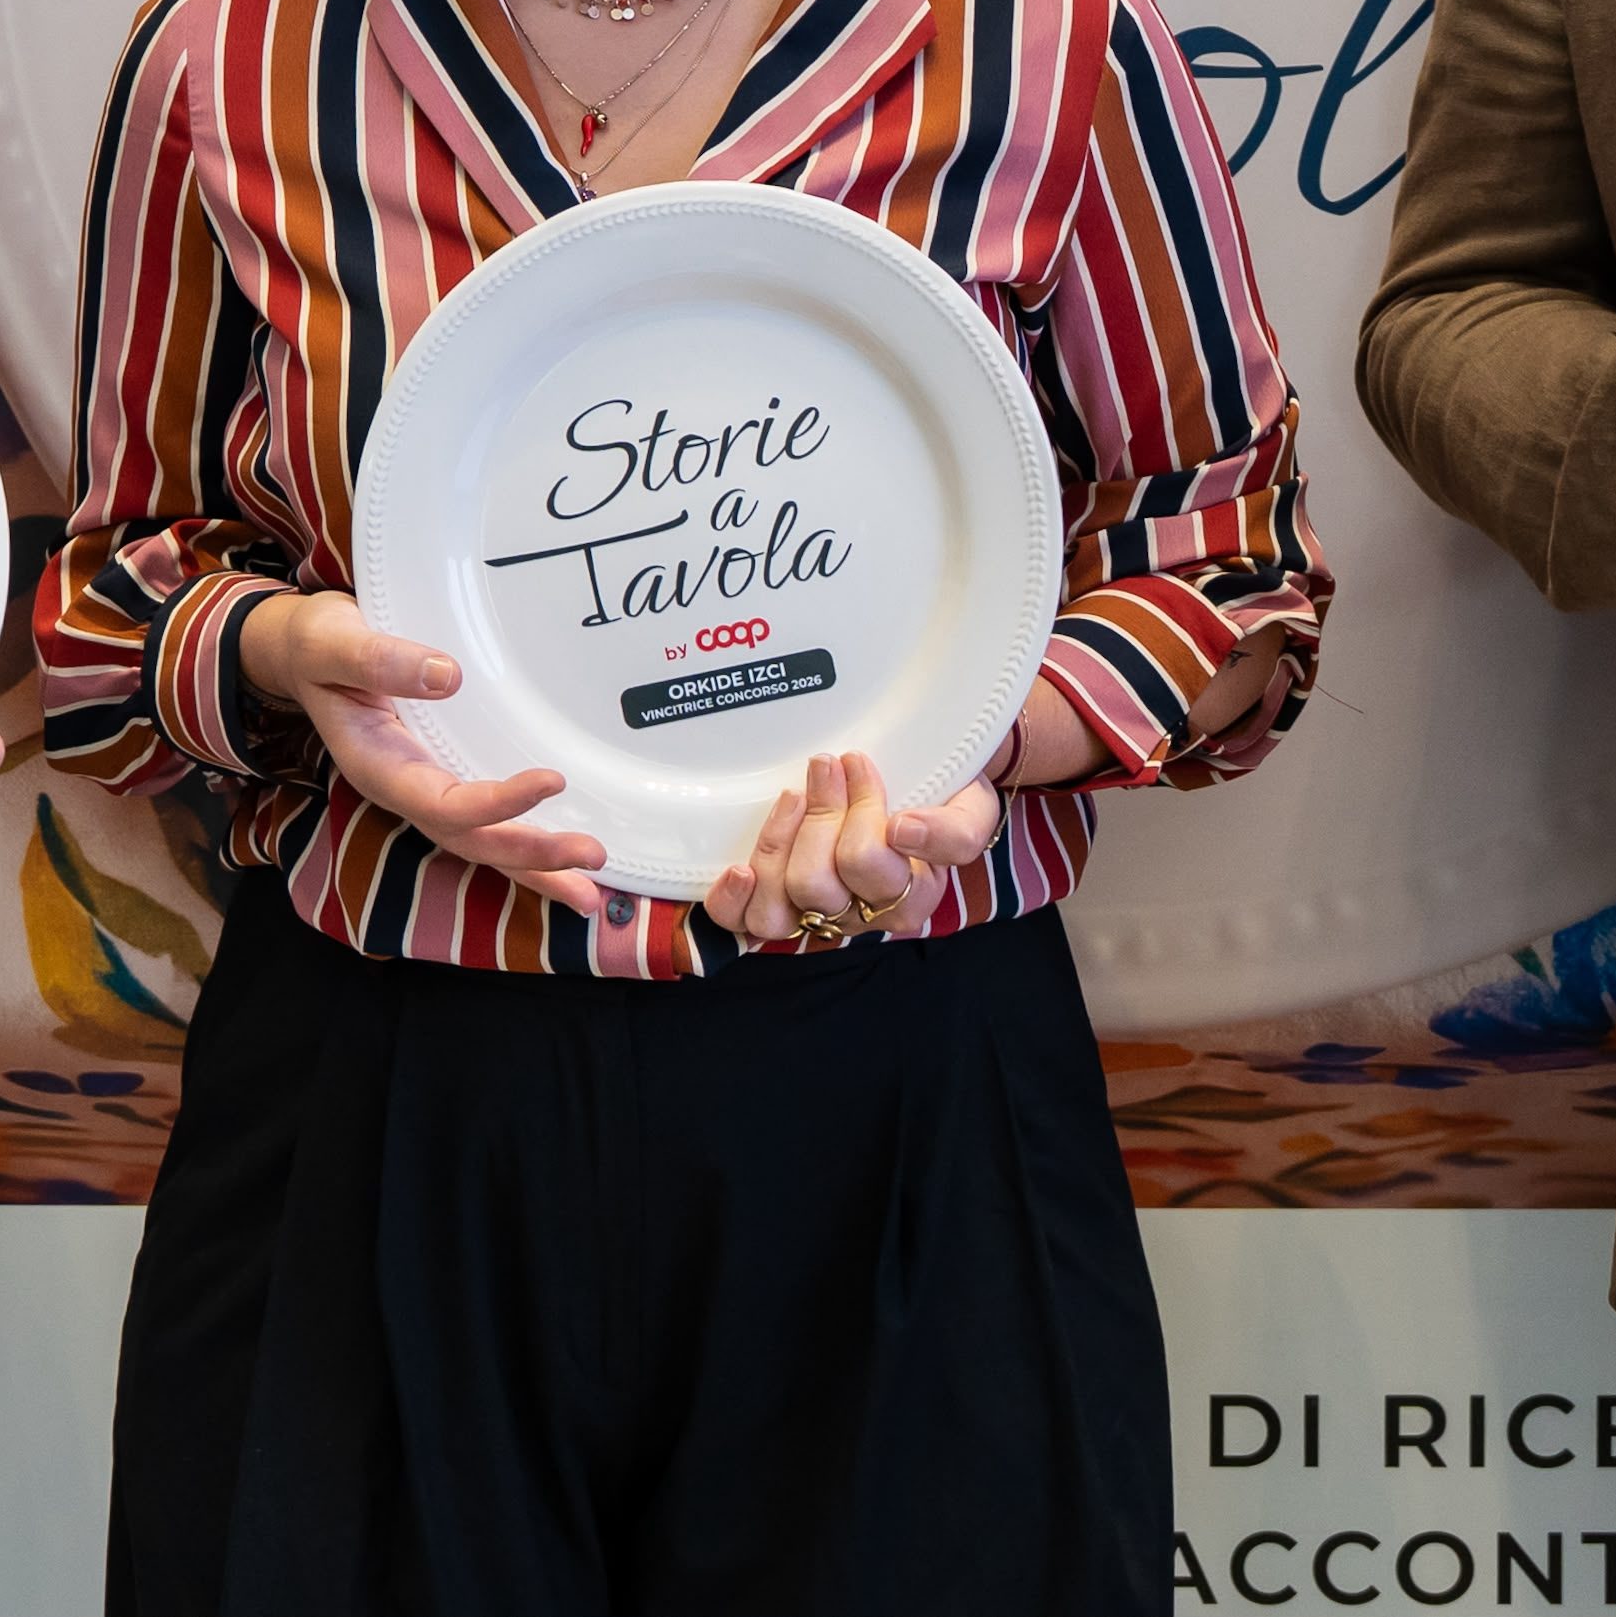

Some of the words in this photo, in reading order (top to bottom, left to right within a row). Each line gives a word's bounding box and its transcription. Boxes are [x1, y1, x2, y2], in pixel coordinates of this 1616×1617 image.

[546, 397, 830, 520] Storie
[710, 488, 759, 532] a
[483, 500, 853, 628] Tavola
[664, 643, 687, 661] by
[695, 617, 771, 653] coop
[641, 697, 714, 722] VINCITRICE
[716, 682, 789, 706] CONCORSO
[791, 674, 823, 691] 2026
[668, 671, 745, 700] ORKIDE
[748, 662, 787, 683] IZCI
[1209, 1394, 1319, 1468] DI
